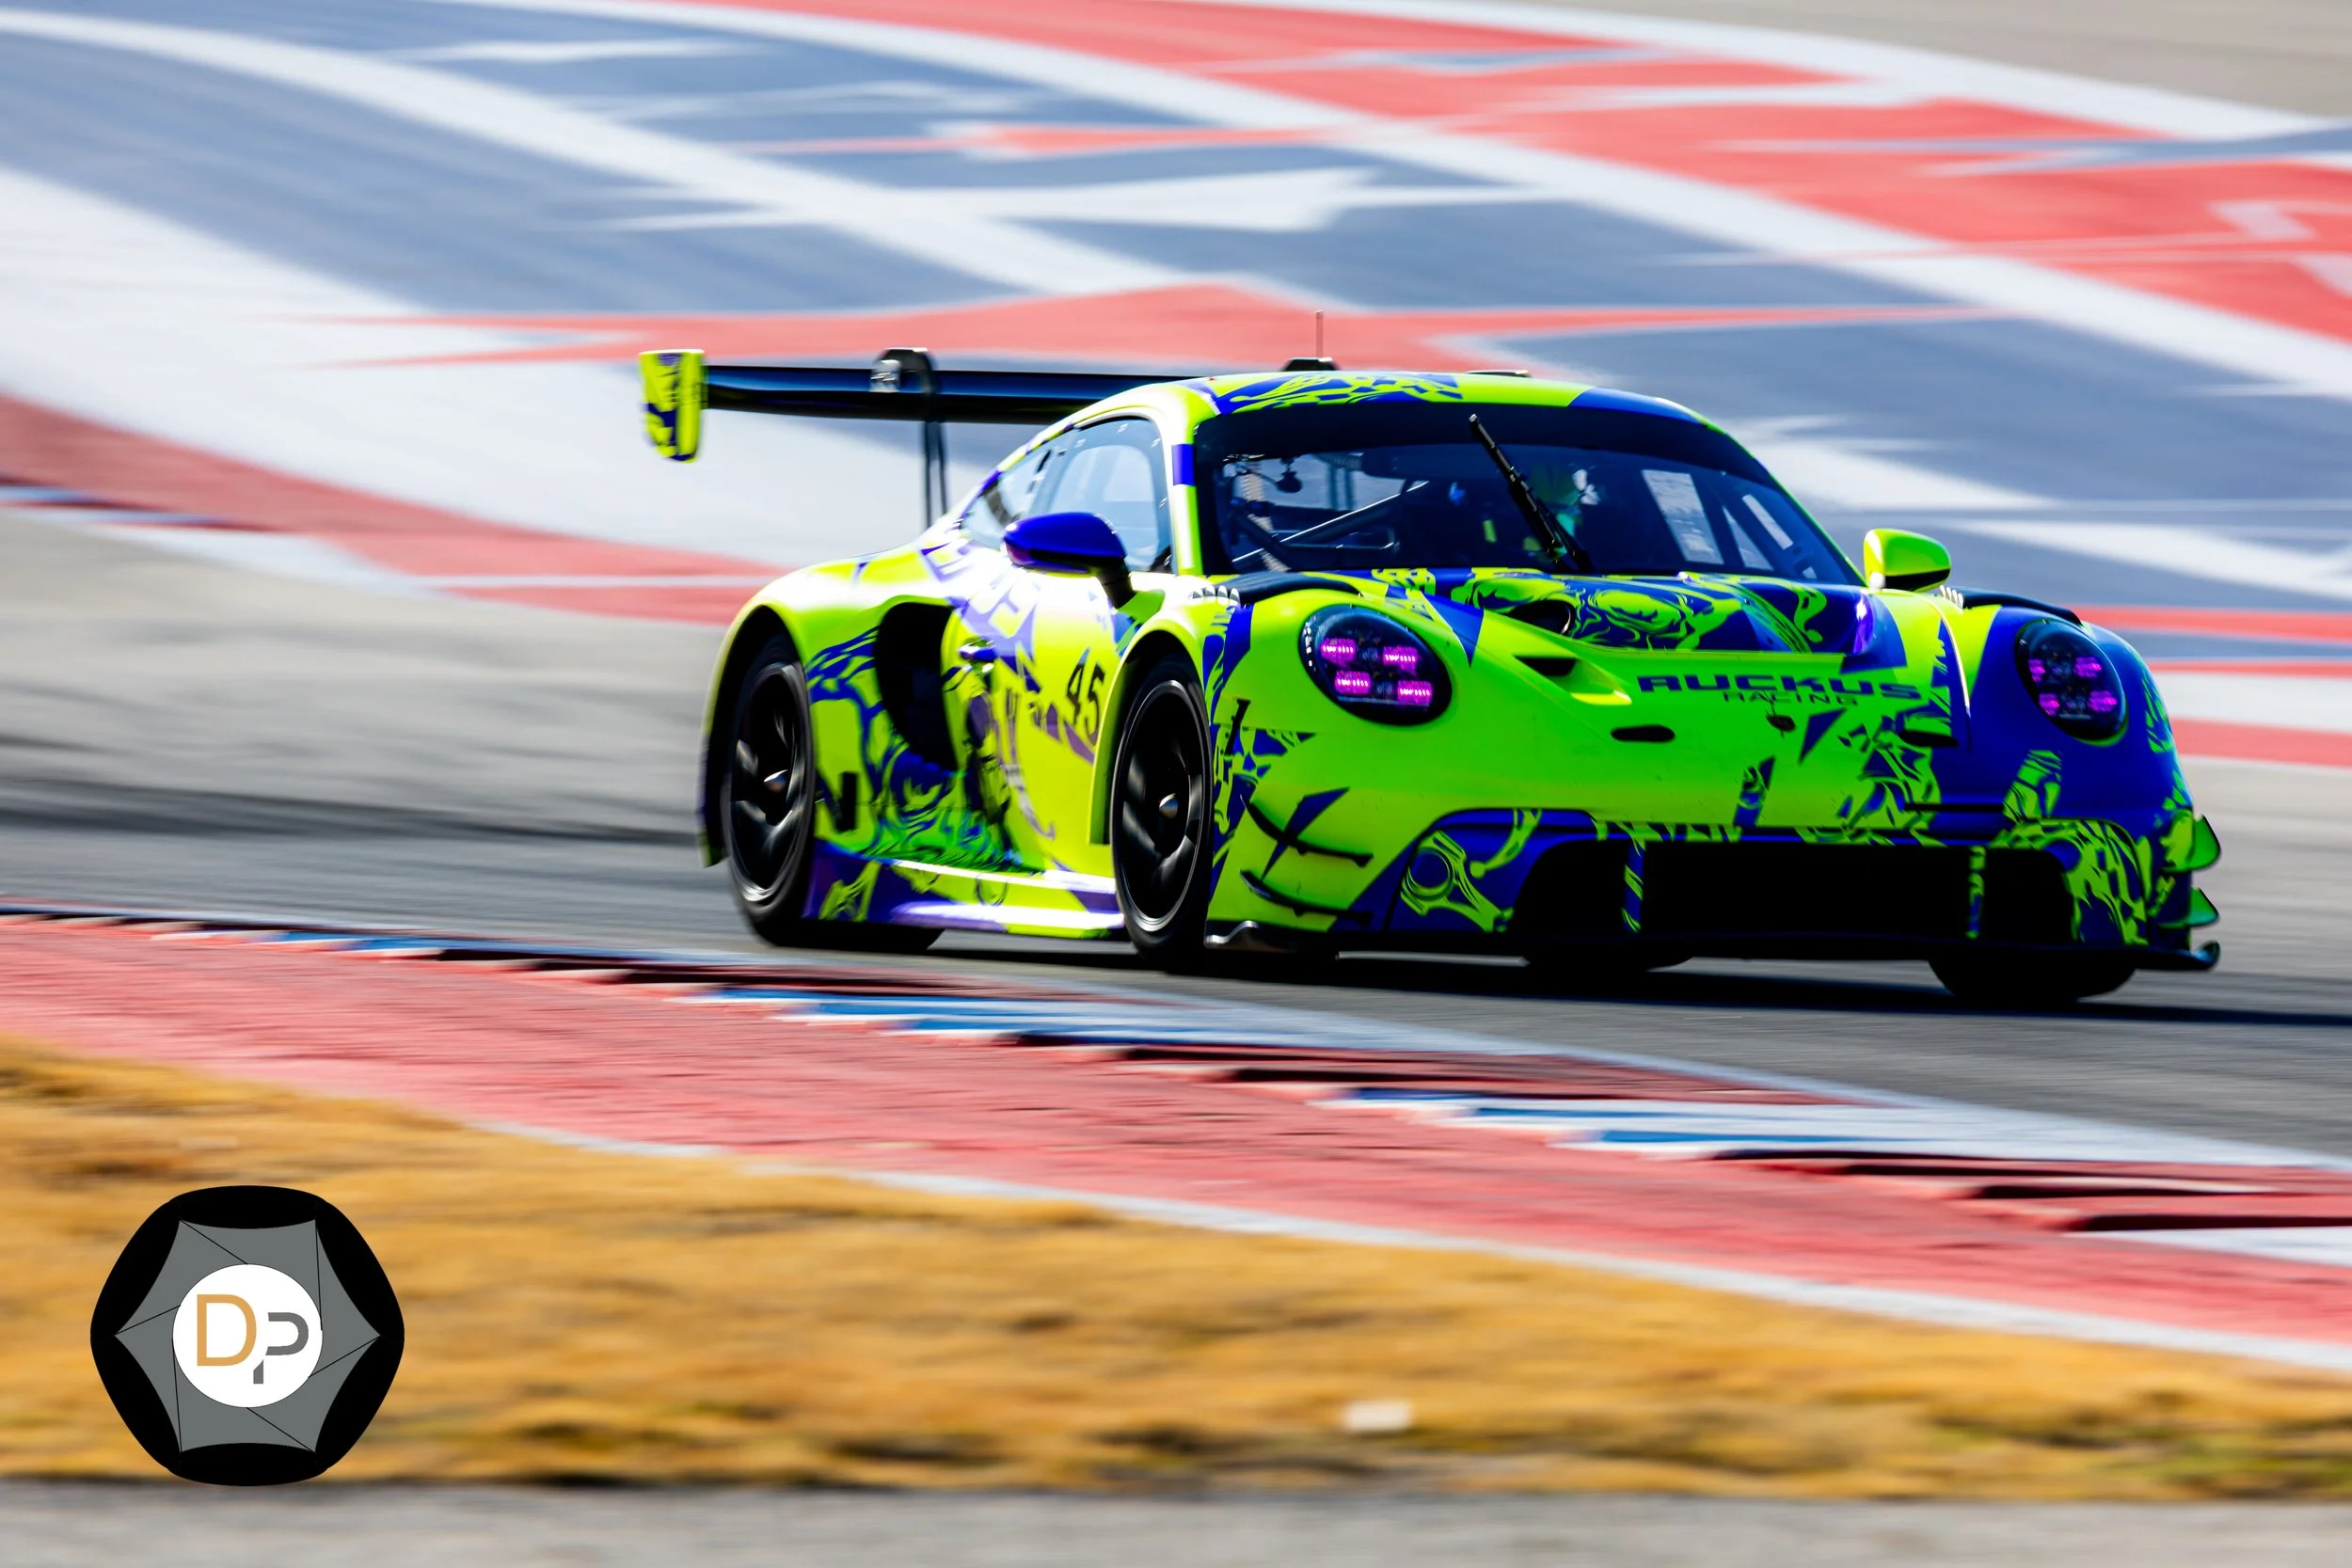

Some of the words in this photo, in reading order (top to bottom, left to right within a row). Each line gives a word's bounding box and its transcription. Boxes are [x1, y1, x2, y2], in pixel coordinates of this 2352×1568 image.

[1066, 647, 1105, 747] 45
[1637, 673, 1922, 700] RUCKUS
[1723, 690, 1859, 706] RACING
